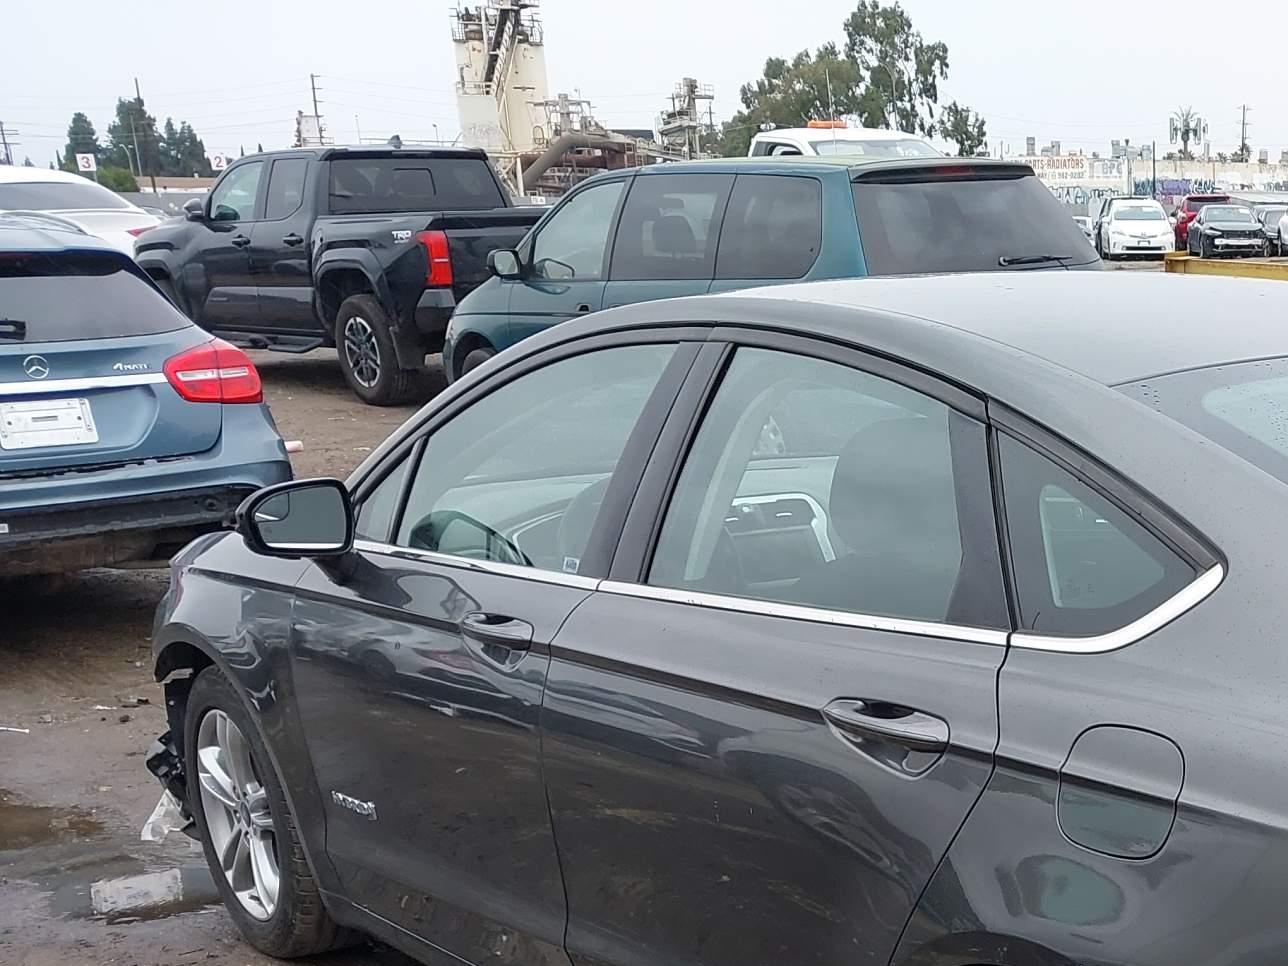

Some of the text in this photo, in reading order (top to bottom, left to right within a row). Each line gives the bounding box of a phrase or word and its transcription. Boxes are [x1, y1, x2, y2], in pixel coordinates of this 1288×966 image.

[80, 156, 92, 169] 3
[214, 155, 224, 168] 2
[391, 230, 412, 240] TRD
[112, 362, 152, 371] 4MATI
